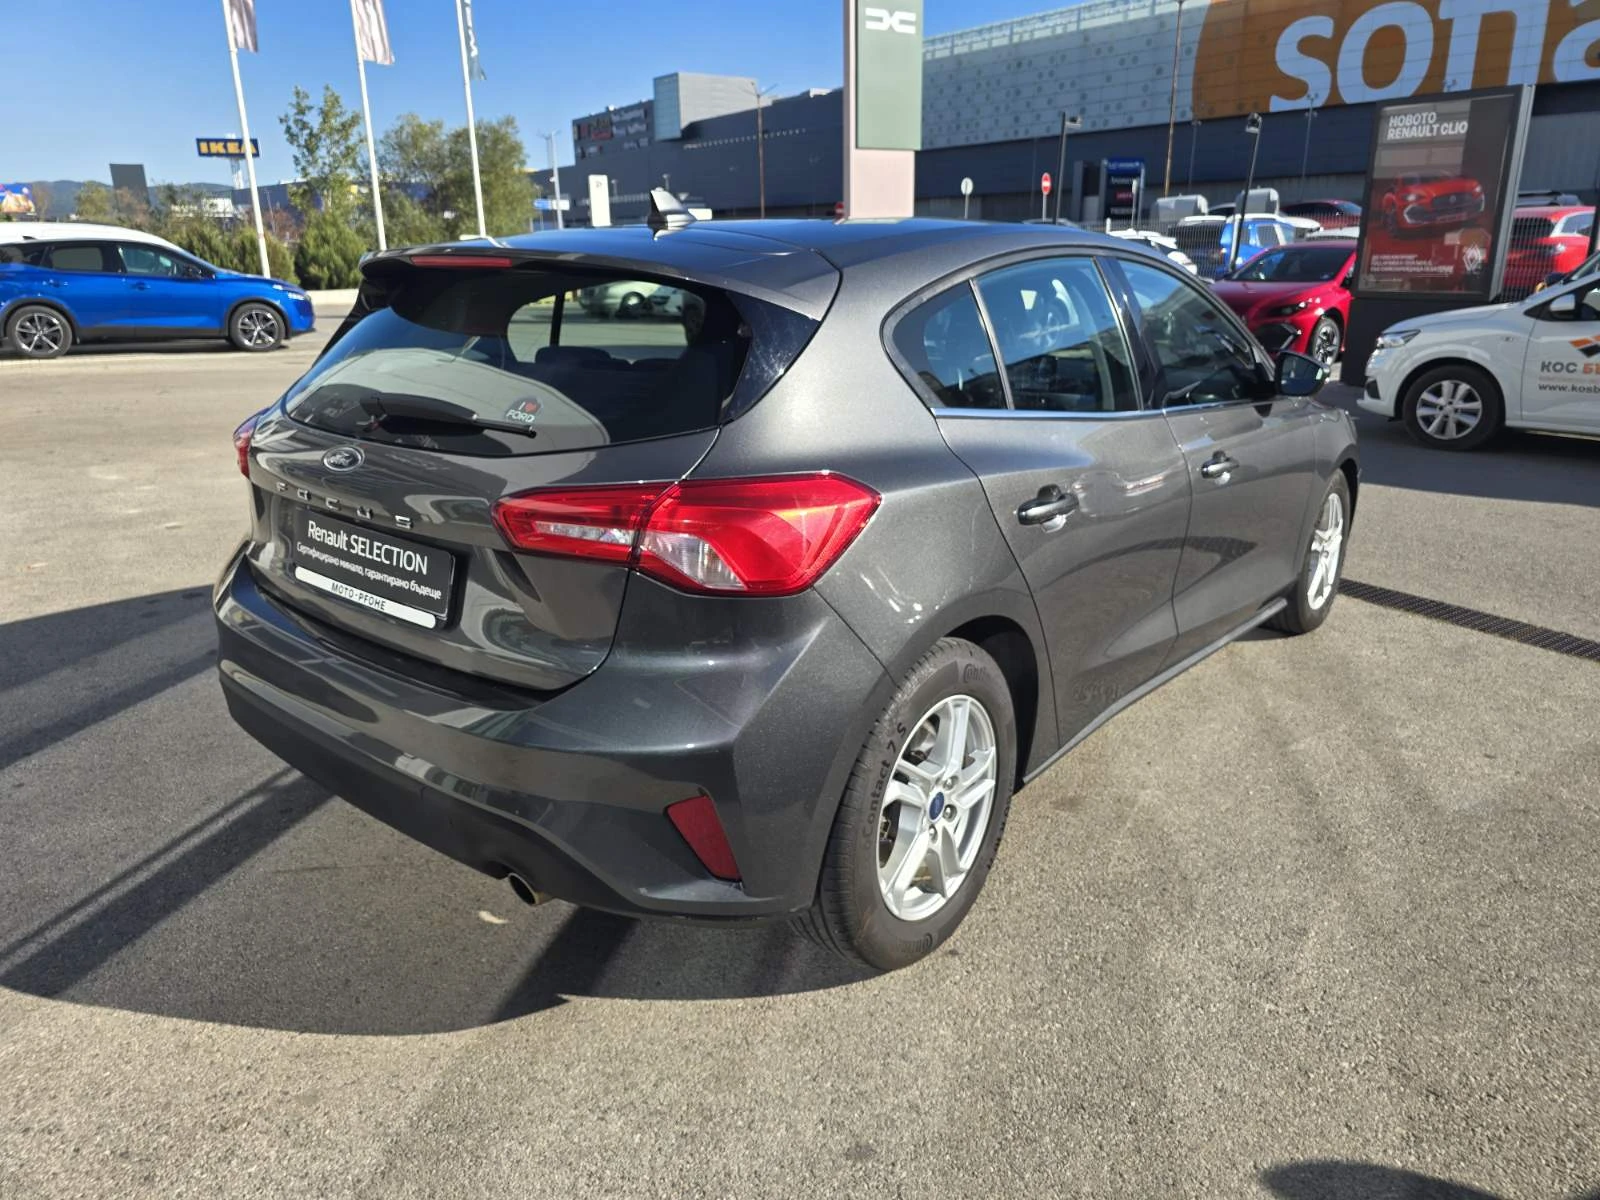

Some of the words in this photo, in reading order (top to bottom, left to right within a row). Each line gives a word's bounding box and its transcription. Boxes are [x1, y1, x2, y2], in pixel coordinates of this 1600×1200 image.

[1386, 124, 1440, 140] RENAULT
[1440, 121, 1469, 136] CLIO
[506, 409, 535, 423] FORD
[276, 481, 414, 530] FOCUS
[308, 520, 348, 551] Renault
[350, 534, 428, 576] SELECTION
[331, 582, 386, 611] MOTO-PFOHE
